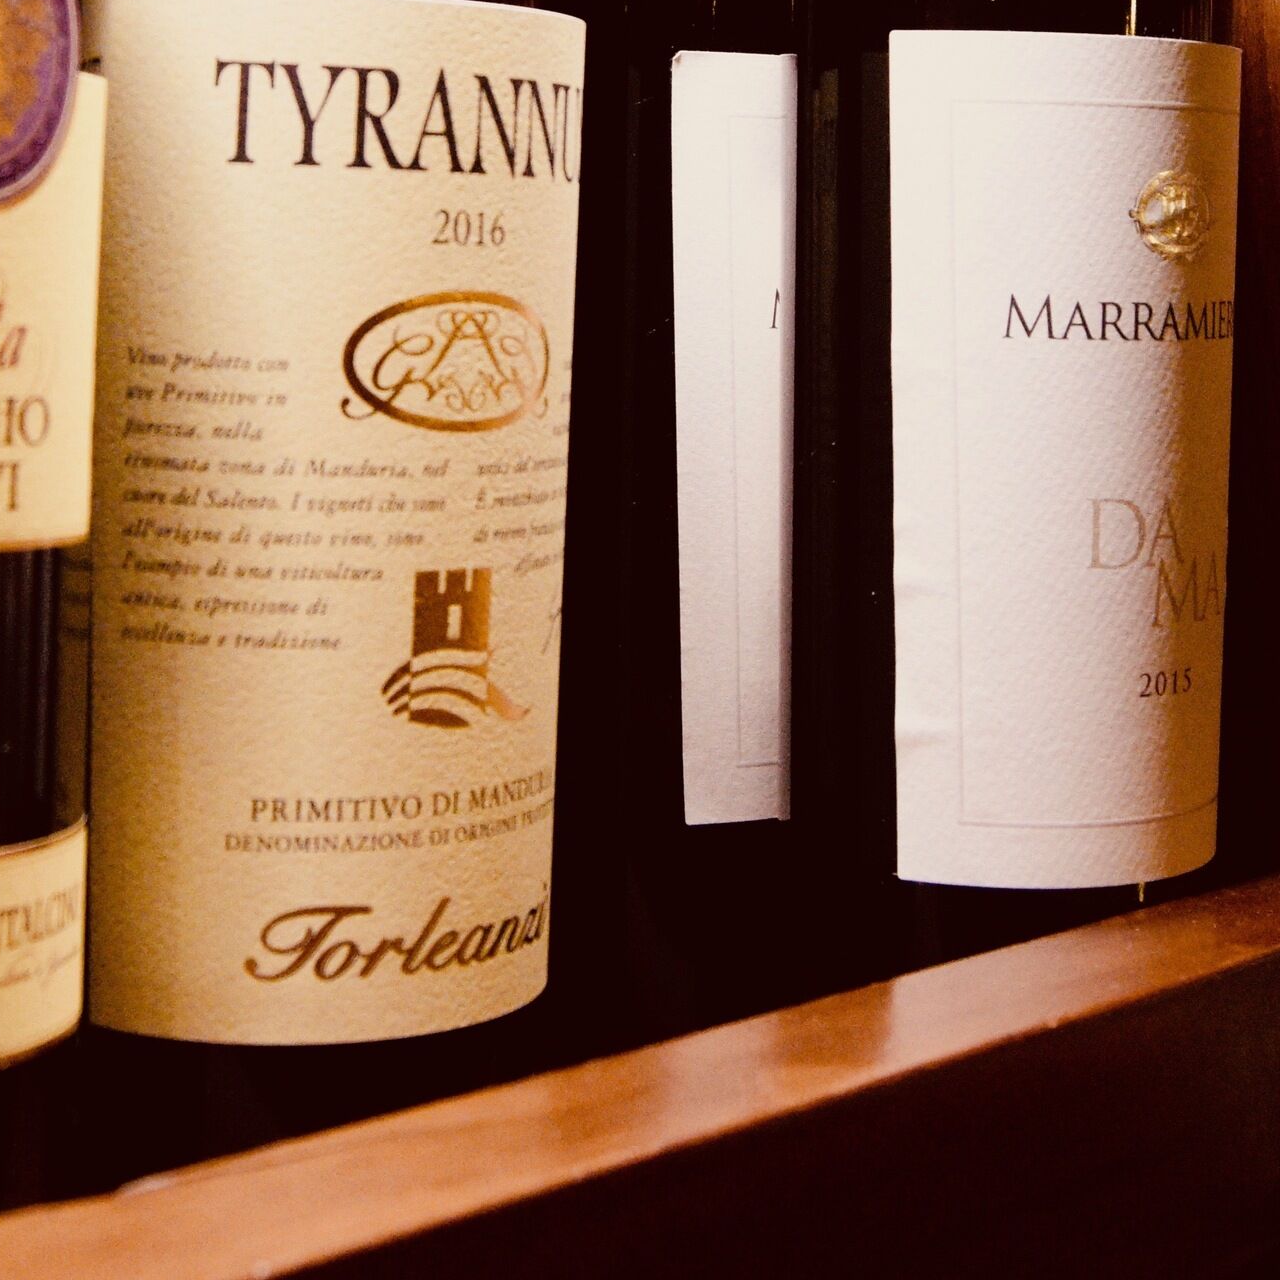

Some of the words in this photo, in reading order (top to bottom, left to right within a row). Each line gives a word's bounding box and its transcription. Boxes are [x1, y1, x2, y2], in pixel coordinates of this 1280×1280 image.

[431, 209, 506, 247] 2016
[1087, 496, 1185, 570] DA
[1151, 550, 1221, 628] MA
[1138, 667, 1193, 698] 2015
[250, 794, 422, 823] PRIMITIVO
[432, 790, 461, 817] DI
[224, 827, 423, 854] DENOMINAZIONE
